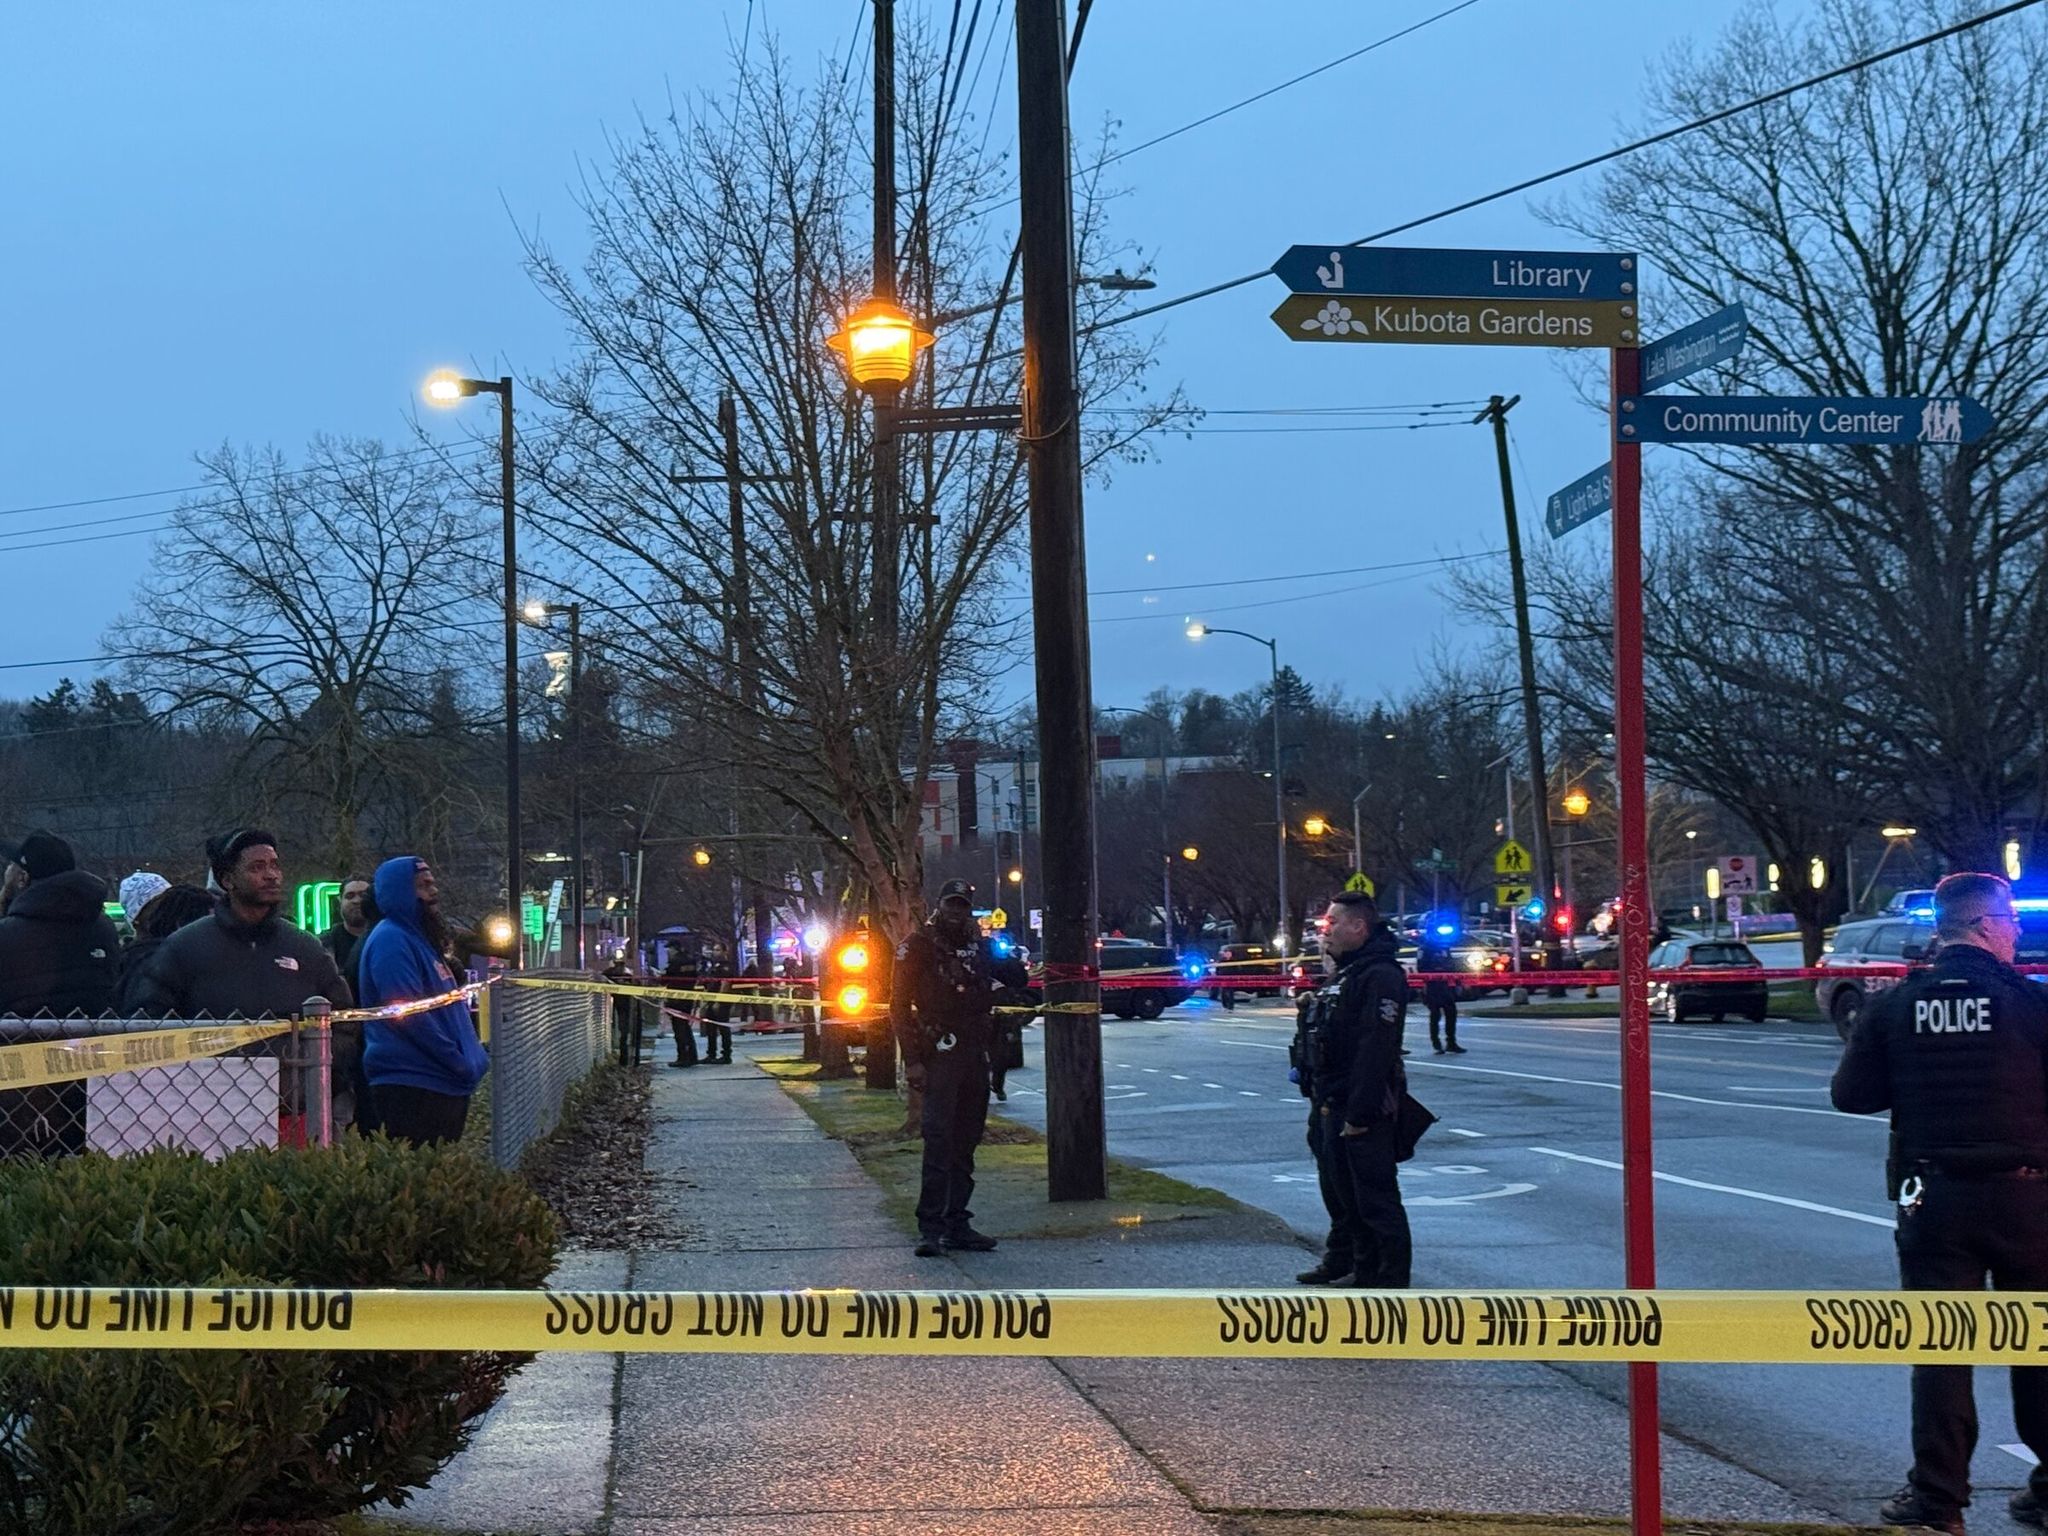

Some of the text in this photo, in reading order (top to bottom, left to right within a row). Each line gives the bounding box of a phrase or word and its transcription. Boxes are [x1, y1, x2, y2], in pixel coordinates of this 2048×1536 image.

[1493, 260, 1592, 293] Library
[1375, 306, 1592, 335] Kubota Gardens
[1645, 333, 1717, 381] Lake Washington
[1663, 406, 1903, 438] Community Center
[1915, 998, 1992, 1033] POLICE
[35, 1289, 92, 1331] DO
[105, 1289, 194, 1332] LINE
[208, 1289, 353, 1331] POLICE
[545, 1292, 1051, 1339] POLICE LINE DO NOT CROSS
[1216, 1295, 1662, 1346] POLICE LINE DO NOT CROSS
[1806, 1298, 1913, 1349] CROSS
[1918, 1300, 1977, 1351] NOT
[1986, 1300, 2029, 1351] DO
